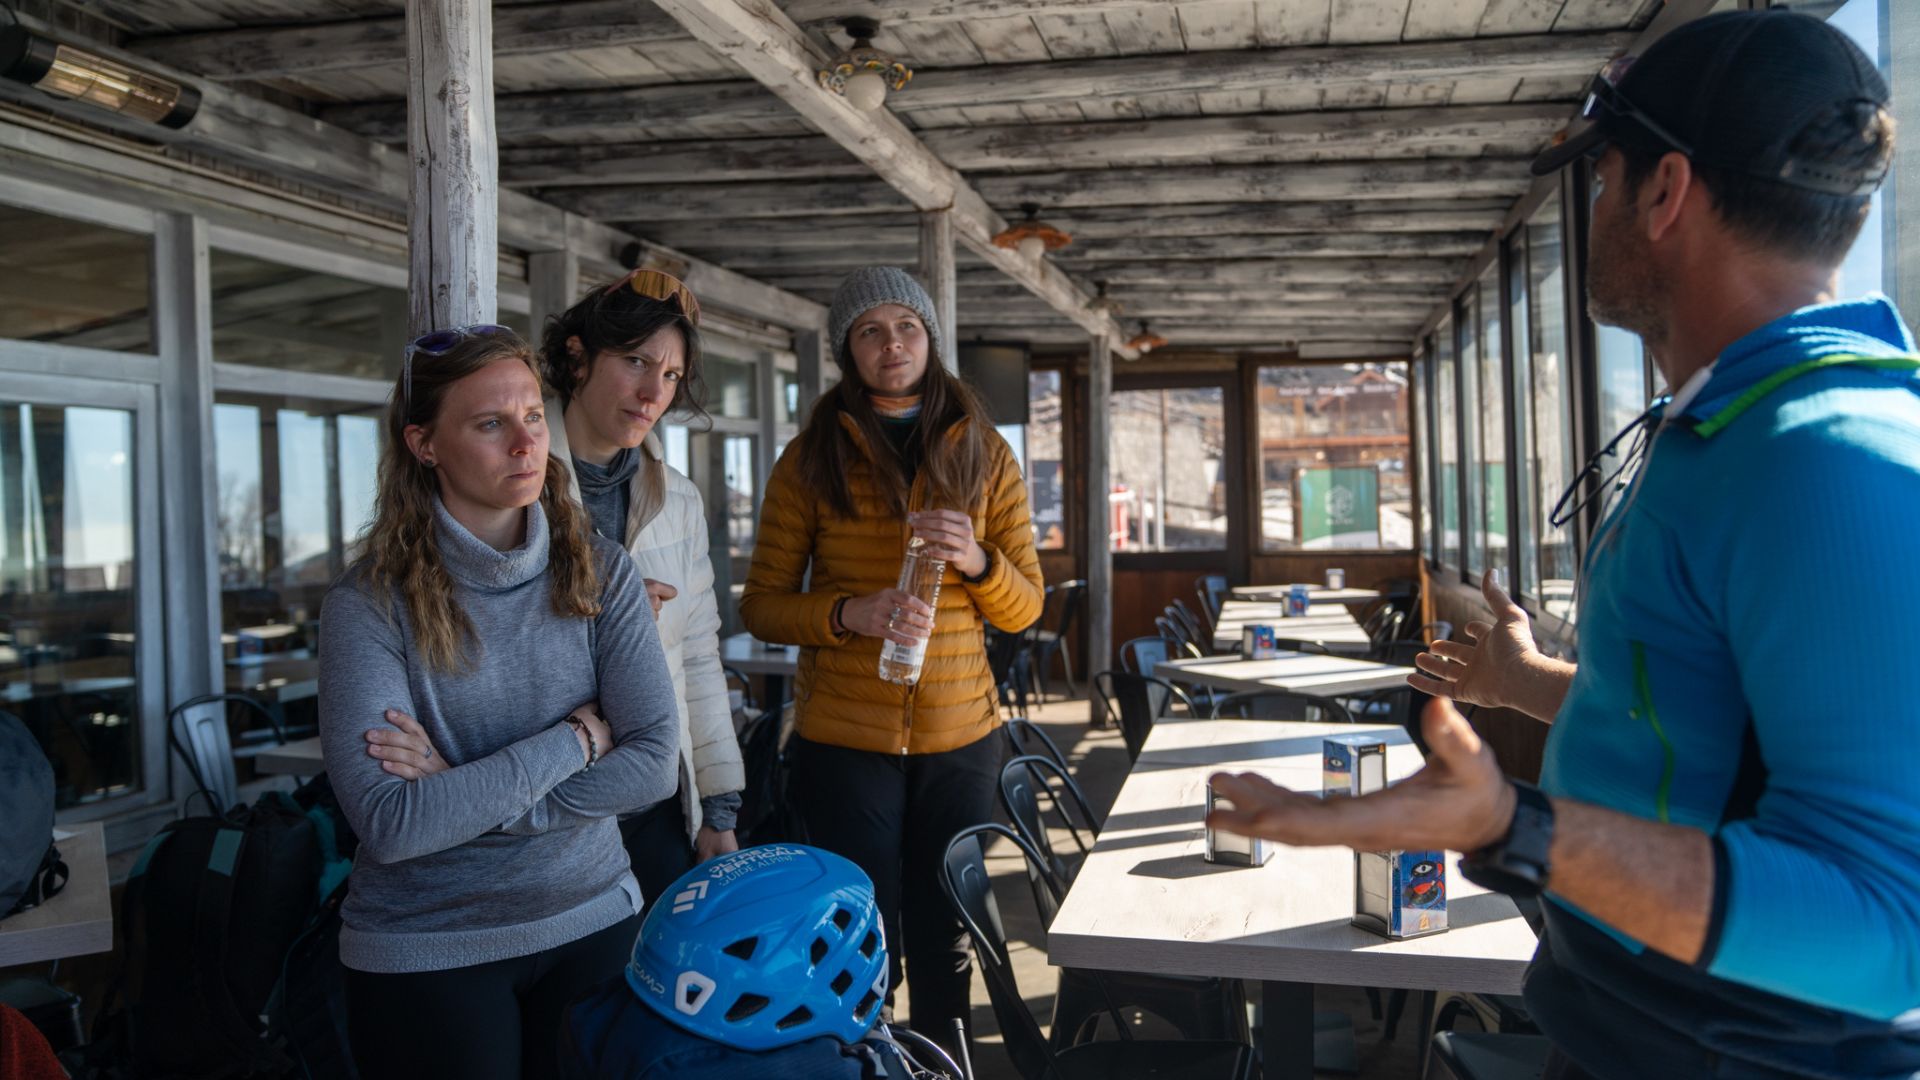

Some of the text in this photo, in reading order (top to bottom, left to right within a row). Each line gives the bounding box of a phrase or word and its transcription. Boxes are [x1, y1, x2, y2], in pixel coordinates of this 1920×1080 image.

[710, 849, 807, 878] VERTICALE
[719, 864, 755, 886] GUIDE
[633, 962, 665, 994] CAMP
